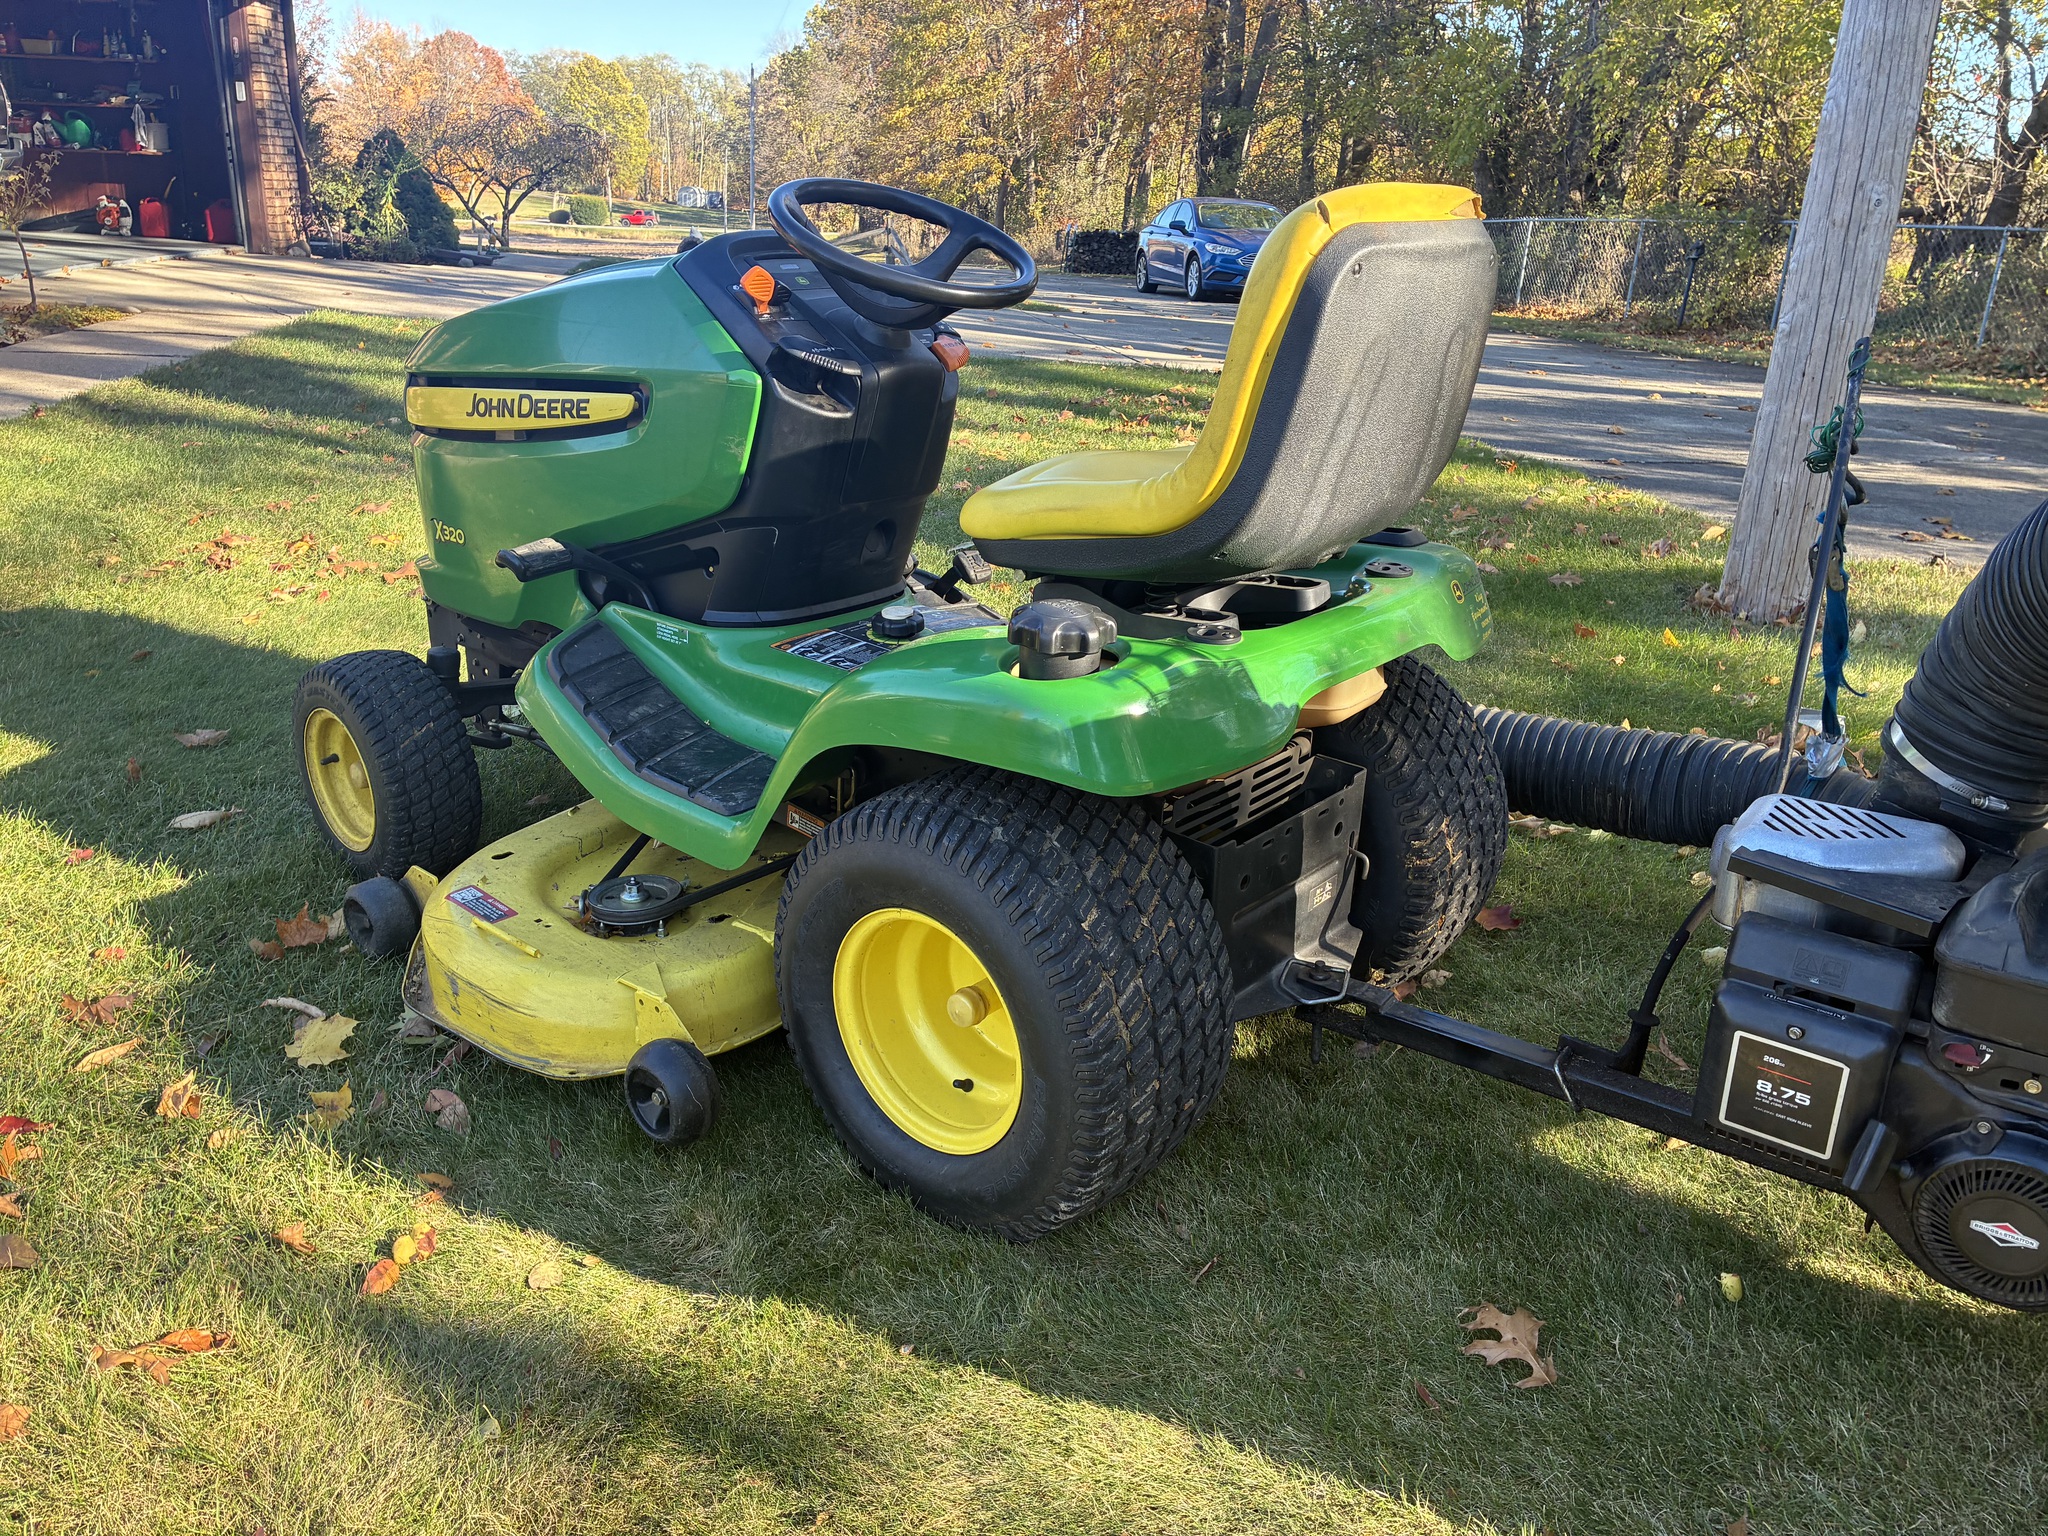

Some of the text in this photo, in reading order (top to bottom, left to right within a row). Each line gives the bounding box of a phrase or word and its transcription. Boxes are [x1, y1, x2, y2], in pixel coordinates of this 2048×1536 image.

[466, 393, 591, 419] JOHN DEERE
[432, 518, 466, 545] X320
[1756, 1079, 1812, 1106] 8.75
[1974, 1223, 1999, 1235] BRIGGS
[2003, 1232, 2035, 1247] STRATTON
